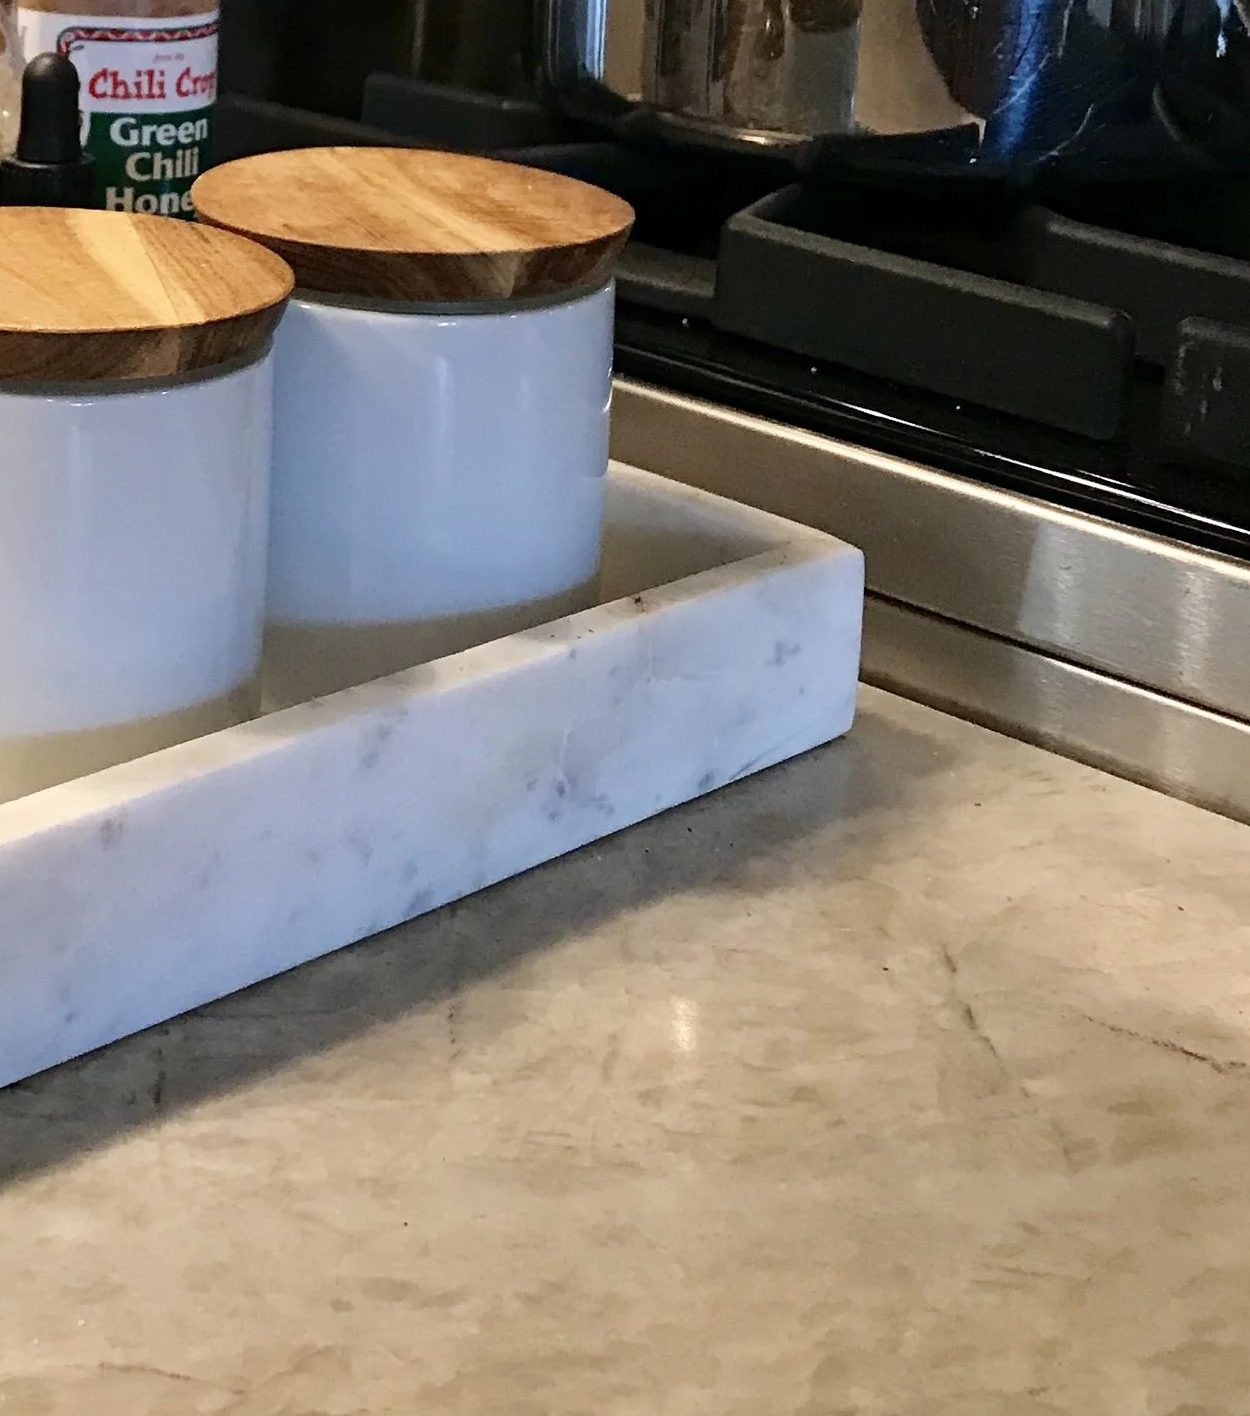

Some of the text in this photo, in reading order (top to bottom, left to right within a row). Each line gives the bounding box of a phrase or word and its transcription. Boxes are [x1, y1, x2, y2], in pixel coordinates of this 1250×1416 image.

[88, 67, 166, 100] Chili
[109, 116, 209, 147] Green
[125, 146, 200, 182] Chili
